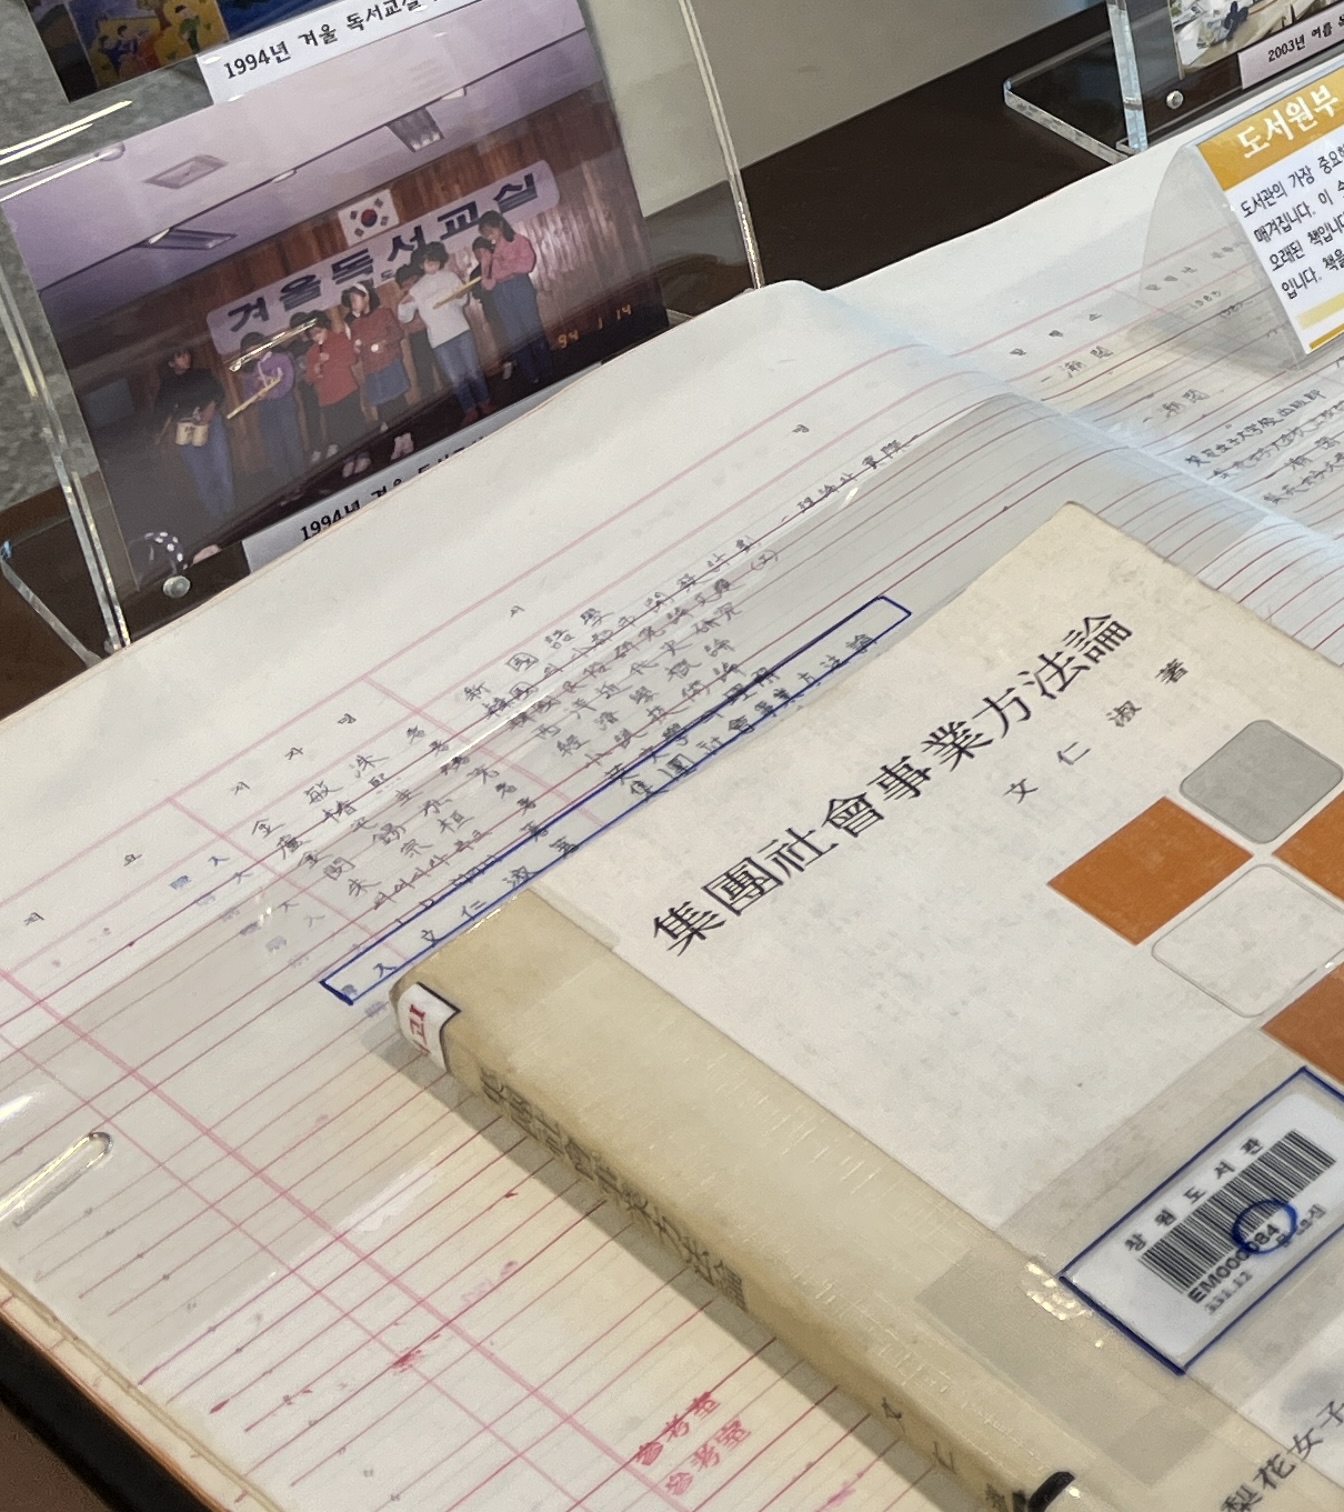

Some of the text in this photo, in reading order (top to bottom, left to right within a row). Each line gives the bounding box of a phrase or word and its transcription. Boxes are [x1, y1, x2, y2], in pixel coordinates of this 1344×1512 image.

[223, 39, 292, 80] 1994년
[297, 22, 339, 49] 겨울
[1267, 36, 1307, 63] 2003년
[1310, 20, 1334, 39] 여름
[1237, 85, 1340, 160] 도서원부
[1240, 180, 1288, 219] 도서관의
[1288, 165, 1314, 188] 가장
[1253, 203, 1316, 245] 매겨집니다.
[1318, 187, 1333, 207] 이
[1269, 242, 1304, 273] 오래된
[1281, 267, 1323, 301] 입니다.
[651, 612, 1135, 957] 集團社會事業方法論
[1123, 1137, 1264, 1252] 창원도서관
[1186, 1223, 1282, 1305] EM000084
